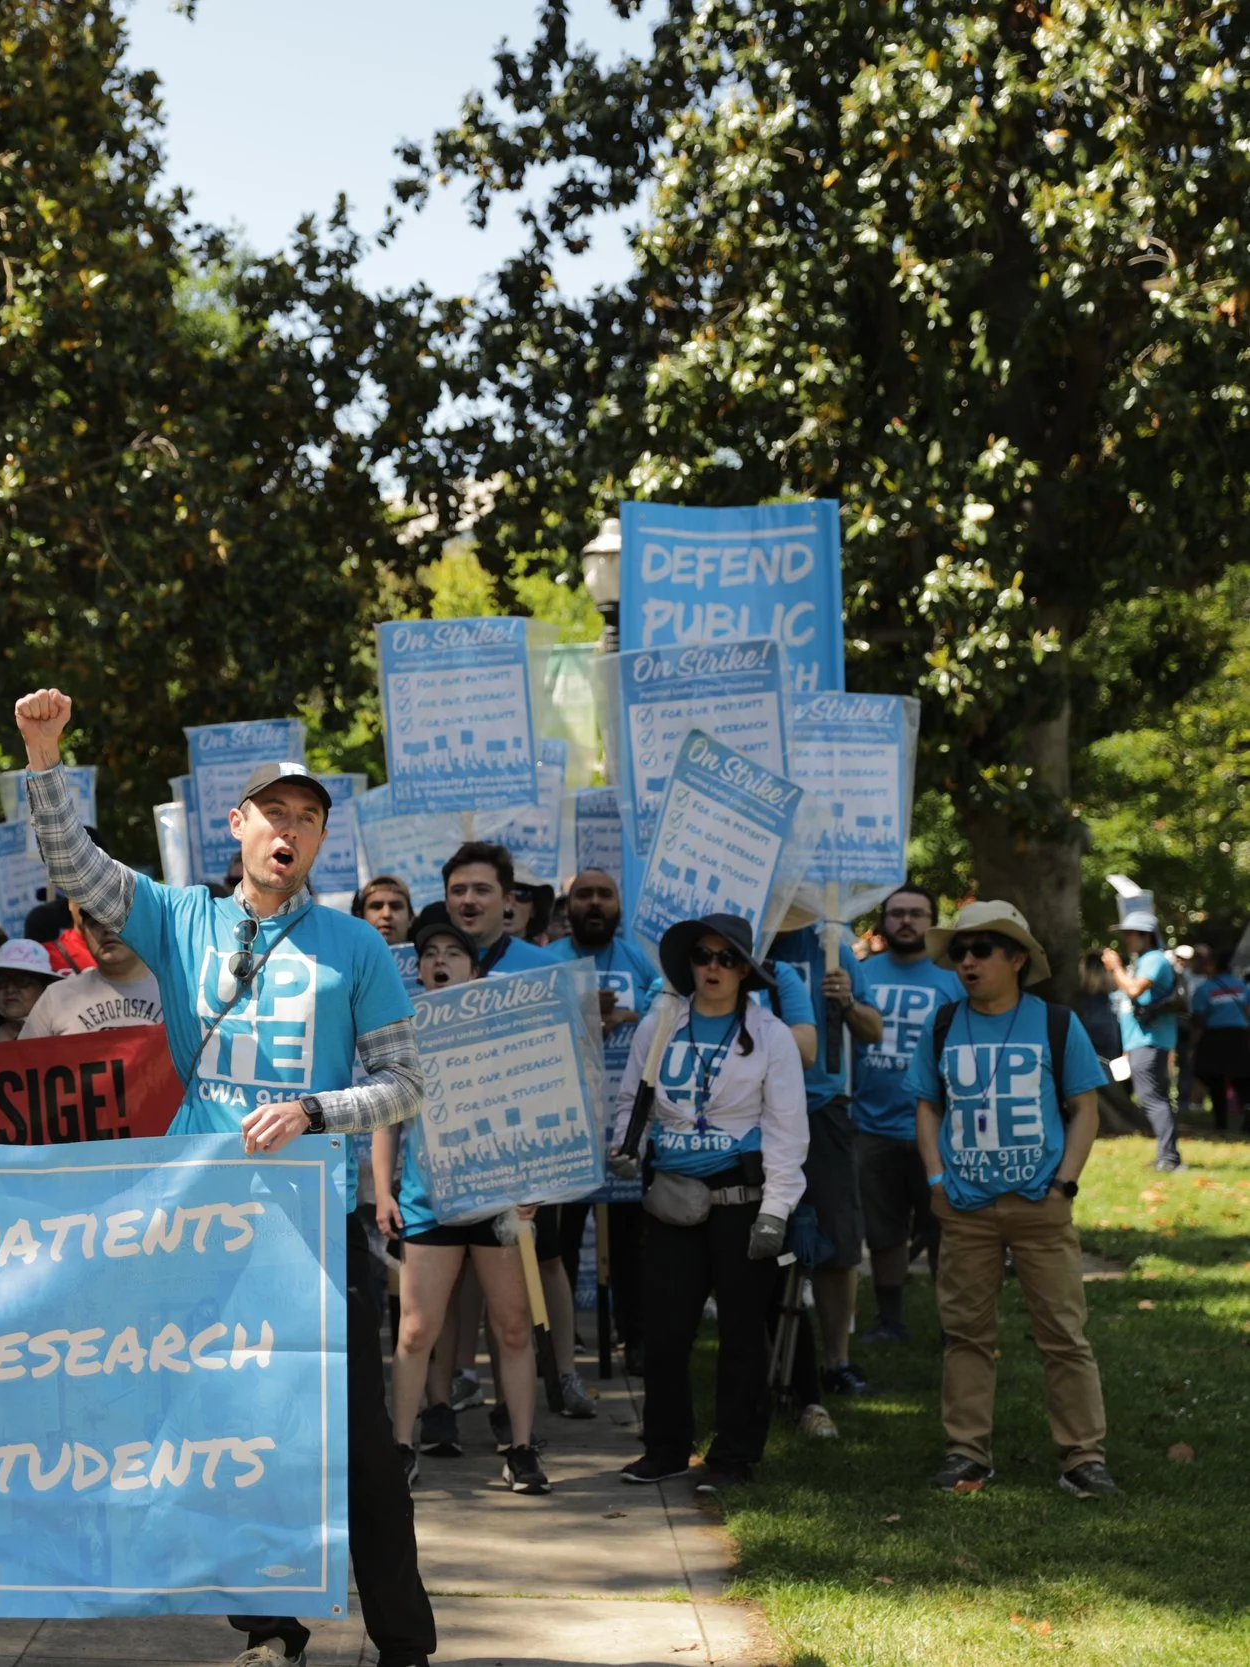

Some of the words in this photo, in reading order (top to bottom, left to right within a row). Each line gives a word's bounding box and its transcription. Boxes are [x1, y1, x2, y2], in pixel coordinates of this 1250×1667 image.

[641, 542, 814, 590] DEFEND
[392, 628, 429, 652] On
[432, 619, 517, 649] Strike!
[642, 597, 815, 646] PUBLIC
[632, 654, 675, 683] On
[676, 641, 771, 677] Strike!
[660, 709, 682, 719] FOR
[687, 706, 708, 717] OUR
[713, 699, 764, 713] PATIENTS
[808, 694, 898, 722] Strike!
[198, 730, 228, 750] On
[687, 738, 722, 771] On
[719, 756, 798, 810] Strike!
[685, 823, 703, 837] FOR
[705, 832, 723, 847] OUR
[692, 801, 710, 816] FOR
[713, 811, 731, 826] OUR
[733, 821, 771, 846] PATIENTS
[679, 843, 698, 859] FOR
[700, 853, 719, 868] OUR
[203, 952, 311, 1017] UP
[411, 1001, 455, 1031] On
[458, 969, 559, 1020] Strike!
[78, 998, 165, 1030] AEROPOSTAL
[203, 1018, 307, 1084] TE
[421, 1031, 455, 1049] Against
[457, 1027, 484, 1041] Unfair
[446, 1055, 471, 1069] FOR
[475, 1048, 499, 1062] OUR
[503, 1032, 556, 1054] PATIENTS
[450, 1077, 473, 1091] FOR
[477, 1072, 502, 1086] OUR
[506, 1055, 563, 1077] RESEARCH
[948, 1046, 1039, 1096] UP
[198, 1081, 248, 1107] CWA
[255, 1089, 310, 1107] 911
[455, 1099, 480, 1114] FOR
[484, 1094, 509, 1109] OUR
[512, 1076, 567, 1099] STUDENTS
[953, 1096, 1041, 1149] TE
[690, 1135, 732, 1151] 9119
[953, 1151, 991, 1167] CWA
[998, 1150, 1043, 1167] 9119
[455, 1164, 515, 1185] University
[519, 1148, 593, 1170] Professional
[470, 1172, 527, 1192] Technical
[529, 1158, 594, 1179] Employees
